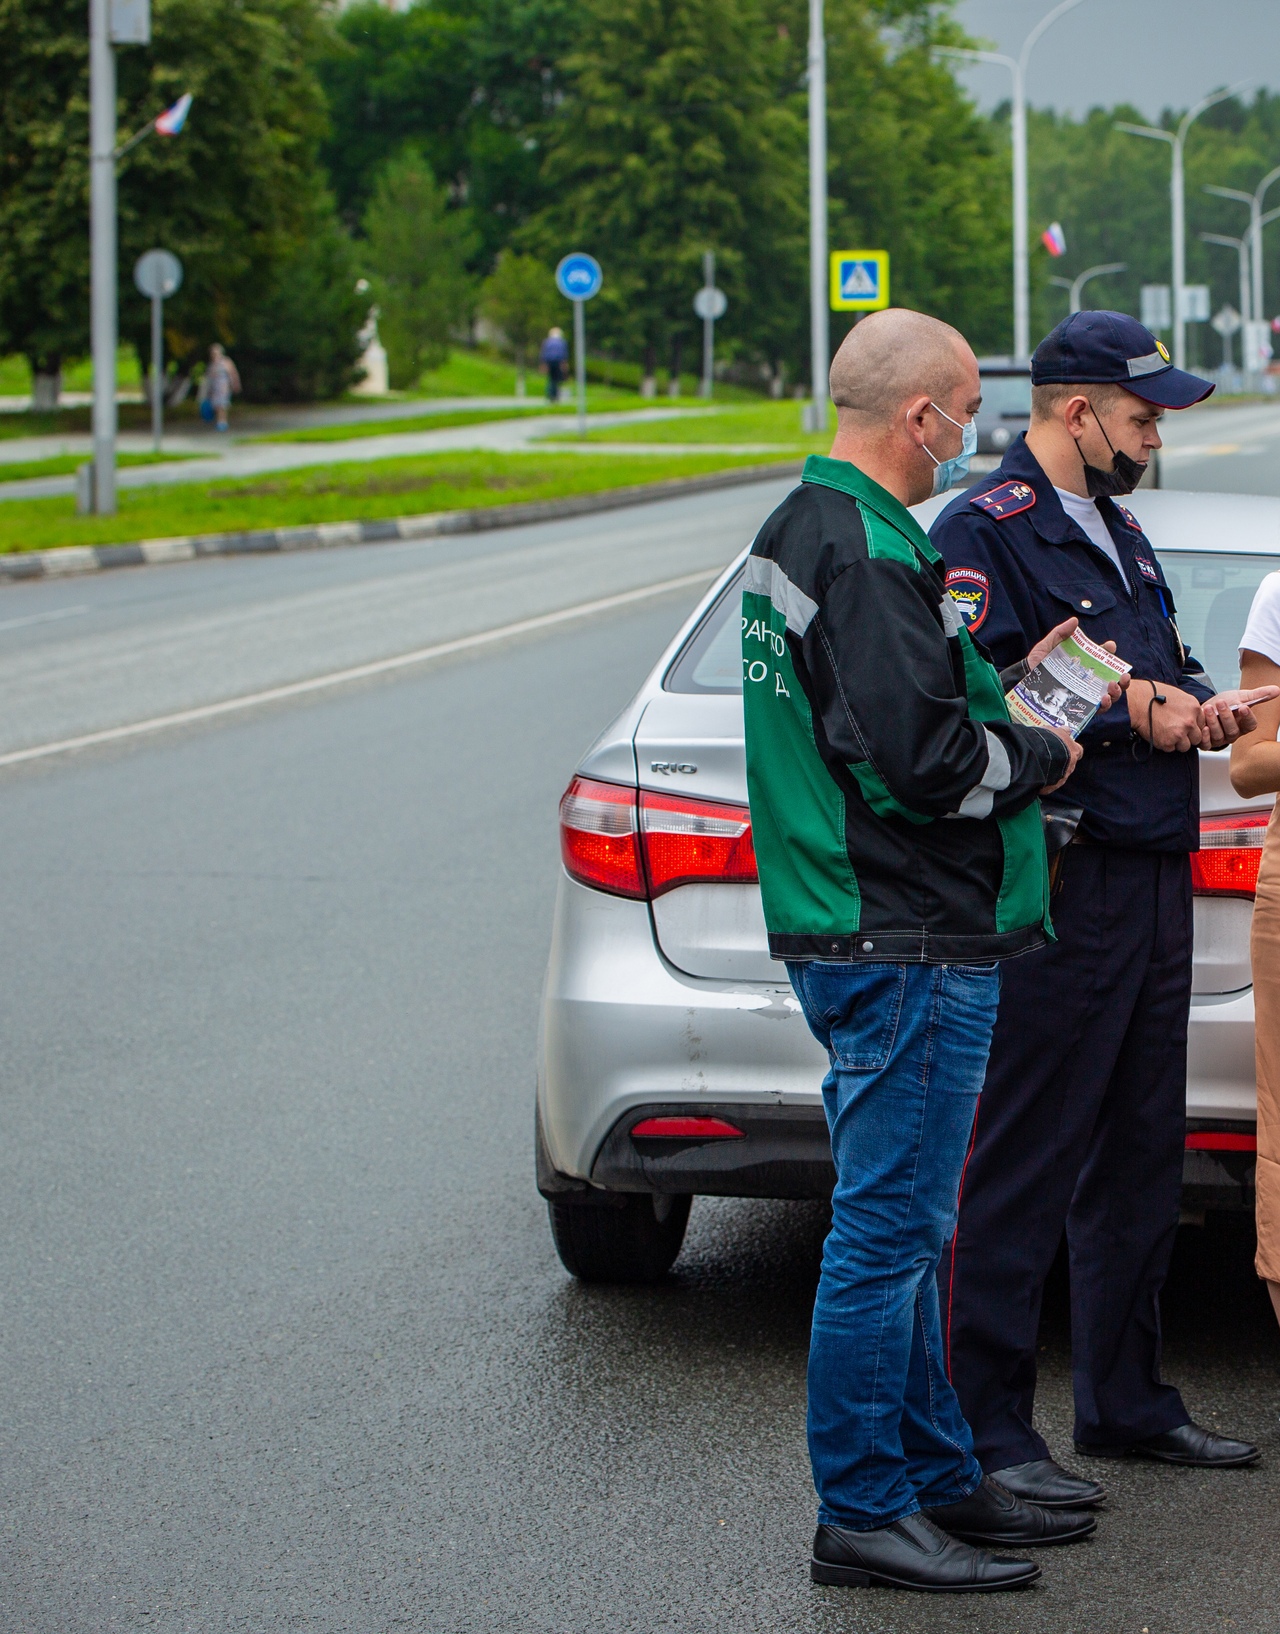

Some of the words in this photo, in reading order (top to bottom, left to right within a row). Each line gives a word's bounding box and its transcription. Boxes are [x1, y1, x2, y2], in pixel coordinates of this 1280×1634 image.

[948, 570, 987, 583] ПОЛИЦИЯ
[1085, 646, 1105, 661] ОБЩАЯ
[1105, 659, 1126, 674] ЗАБОТА
[1014, 701, 1042, 726] ДОБРЫЙ
[651, 761, 698, 776] RIO
